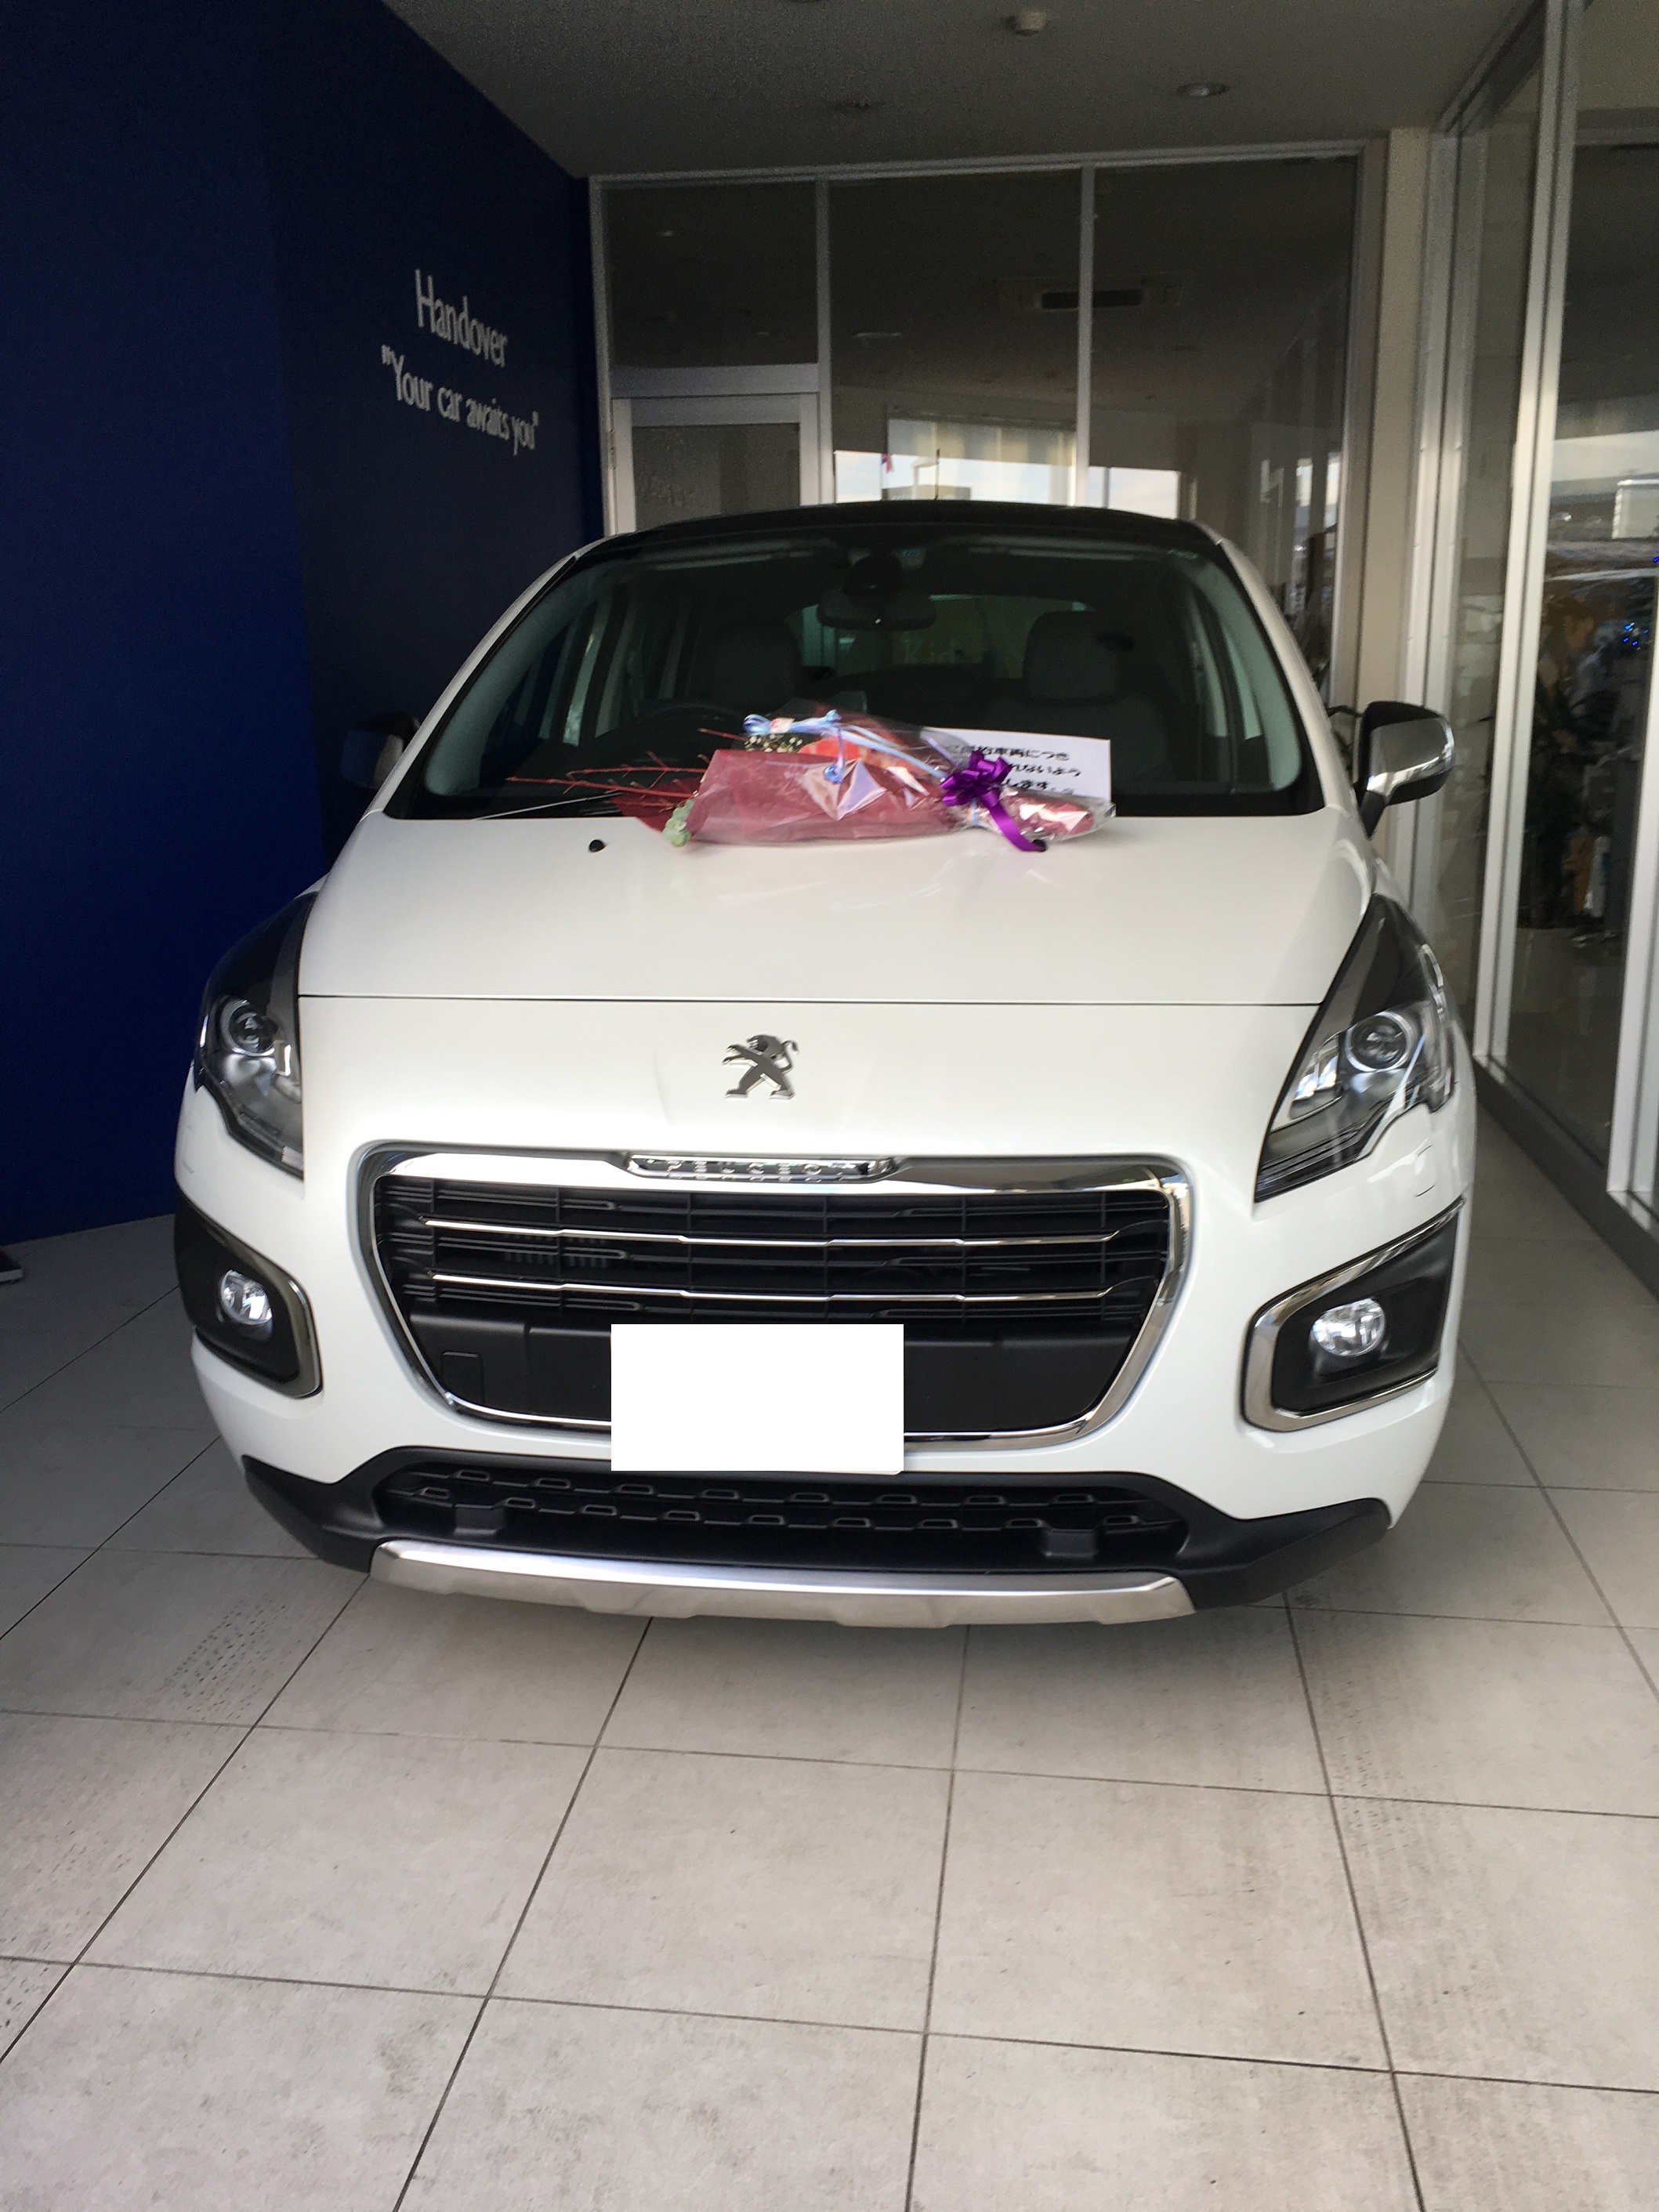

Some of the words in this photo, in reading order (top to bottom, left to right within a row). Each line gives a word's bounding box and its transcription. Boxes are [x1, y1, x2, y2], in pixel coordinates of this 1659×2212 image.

[415, 269, 508, 367] Handover
[437, 387, 463, 422] car
[465, 397, 509, 440] awaits
